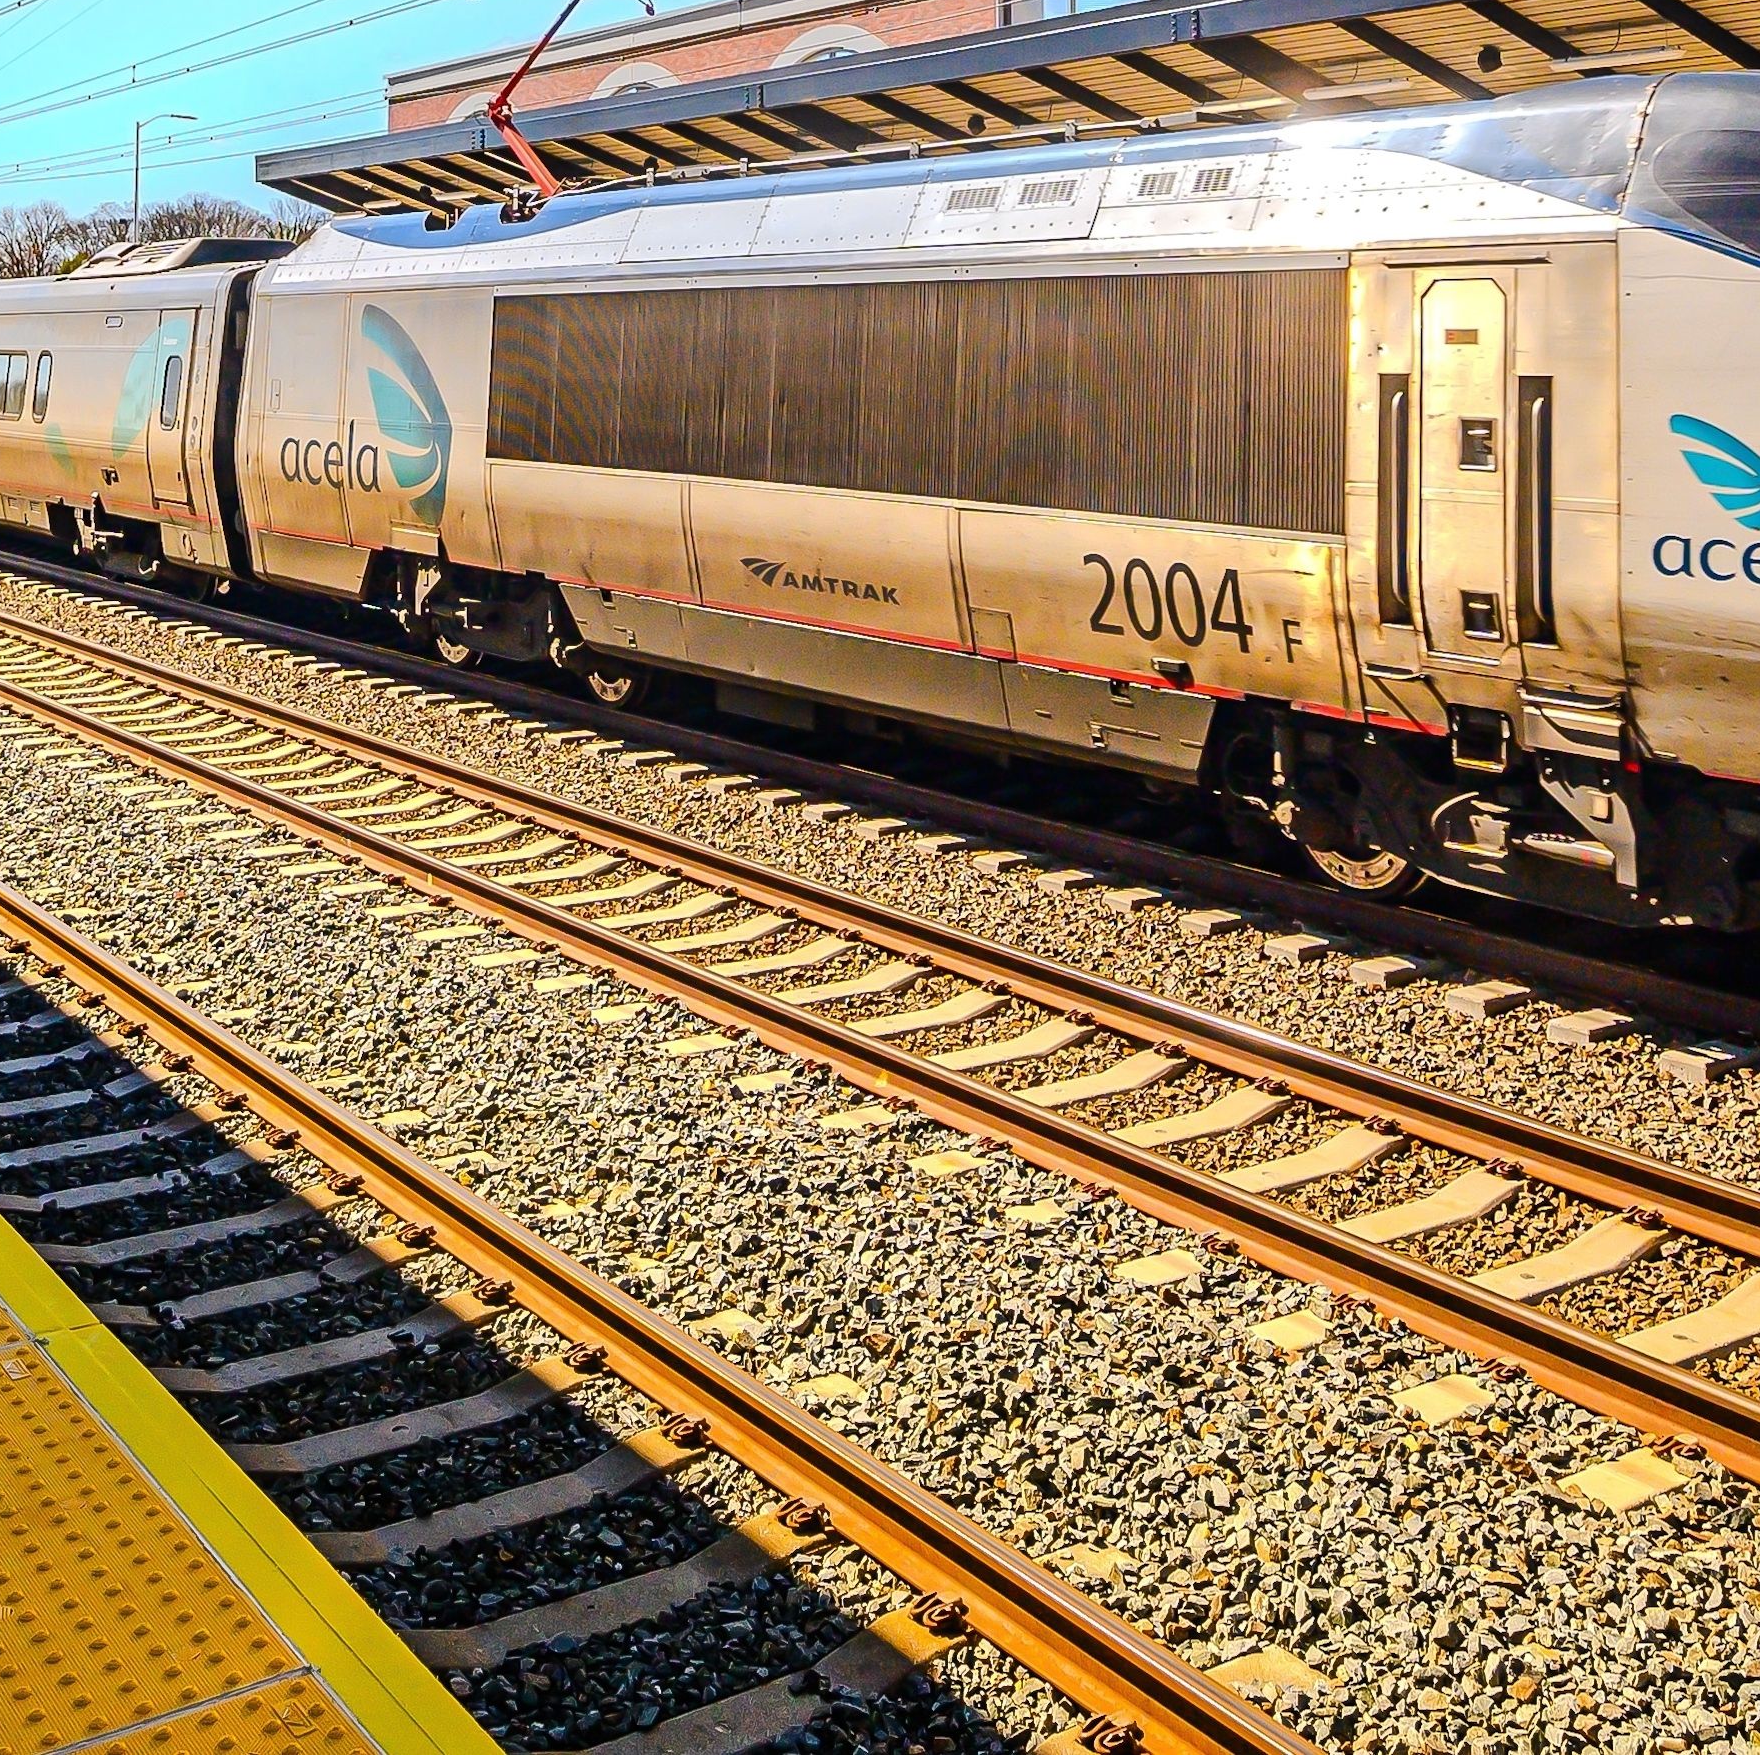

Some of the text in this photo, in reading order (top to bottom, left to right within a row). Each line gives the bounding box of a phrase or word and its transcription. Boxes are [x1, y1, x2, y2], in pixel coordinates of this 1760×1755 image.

[280, 418, 382, 493] acela
[782, 571, 901, 606] AMTRAK
[1083, 553, 1304, 664] 2004 F
